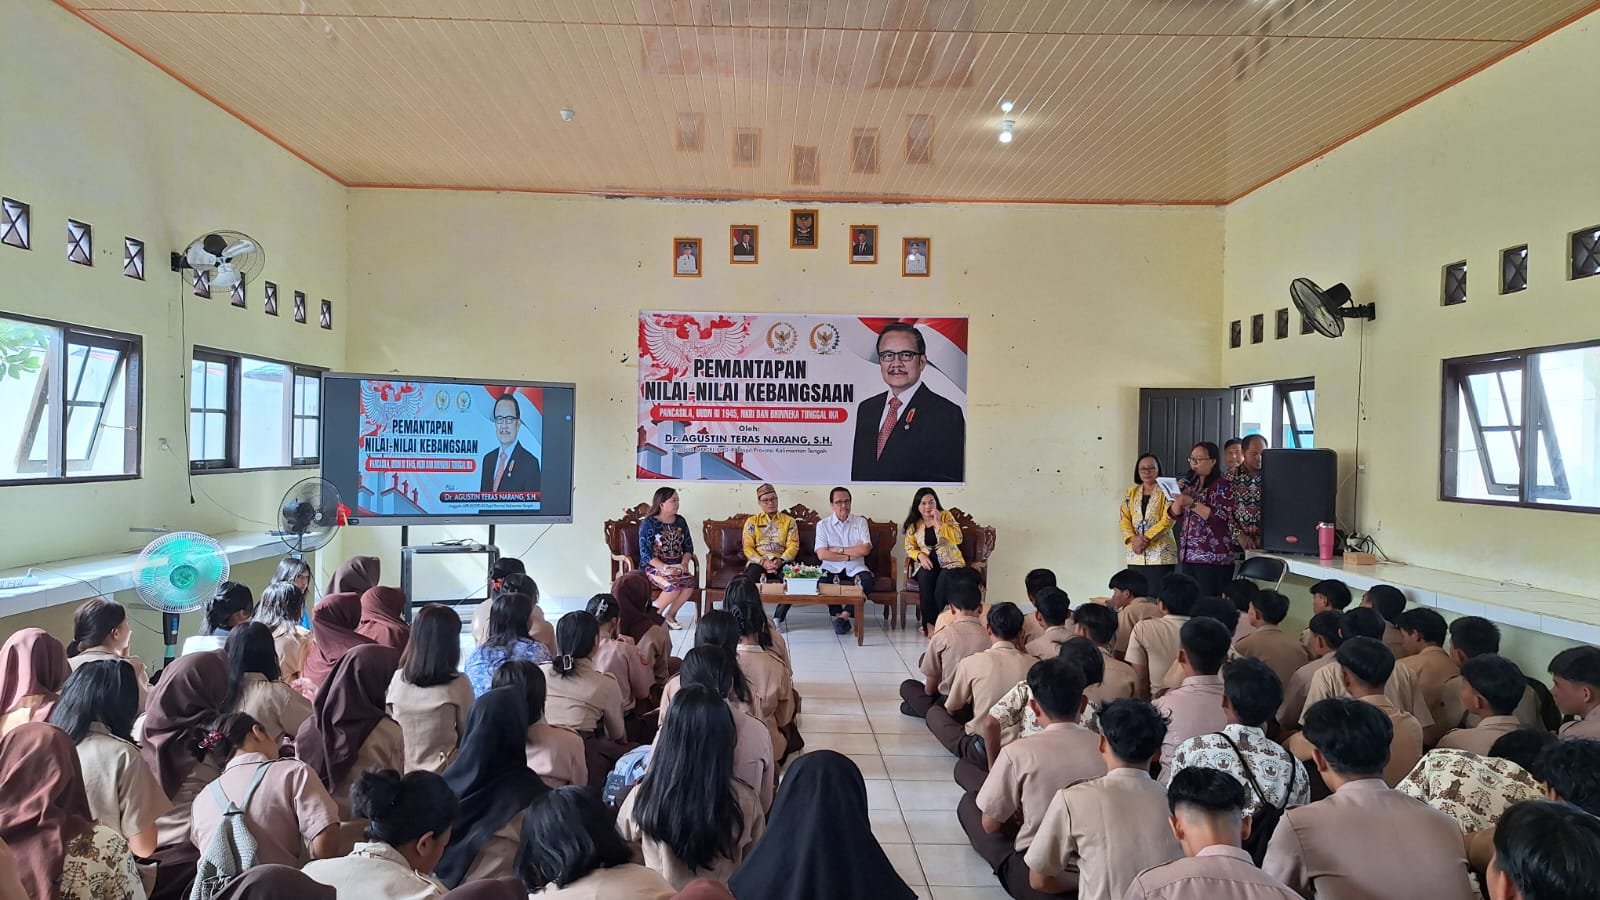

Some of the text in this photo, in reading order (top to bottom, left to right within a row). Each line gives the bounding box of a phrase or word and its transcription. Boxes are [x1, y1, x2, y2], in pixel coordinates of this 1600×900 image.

[693, 359, 807, 379] PEMANTAPAN
[644, 381, 854, 403] NILAI-NILAI KEBANGSAAN
[722, 408, 739, 420] 1945,
[756, 409, 769, 419] DAN
[392, 420, 454, 434] PEMANTAPAN
[364, 438, 478, 453] NILAI-NILAI KEBANGSAAN
[665, 434, 833, 446] Dr. AGUSTIN TERAS NARANG, S.H.
[775, 447, 807, 455] Kalimantan
[807, 447, 828, 455] Tengah
[499, 493, 526, 501] NARANG,
